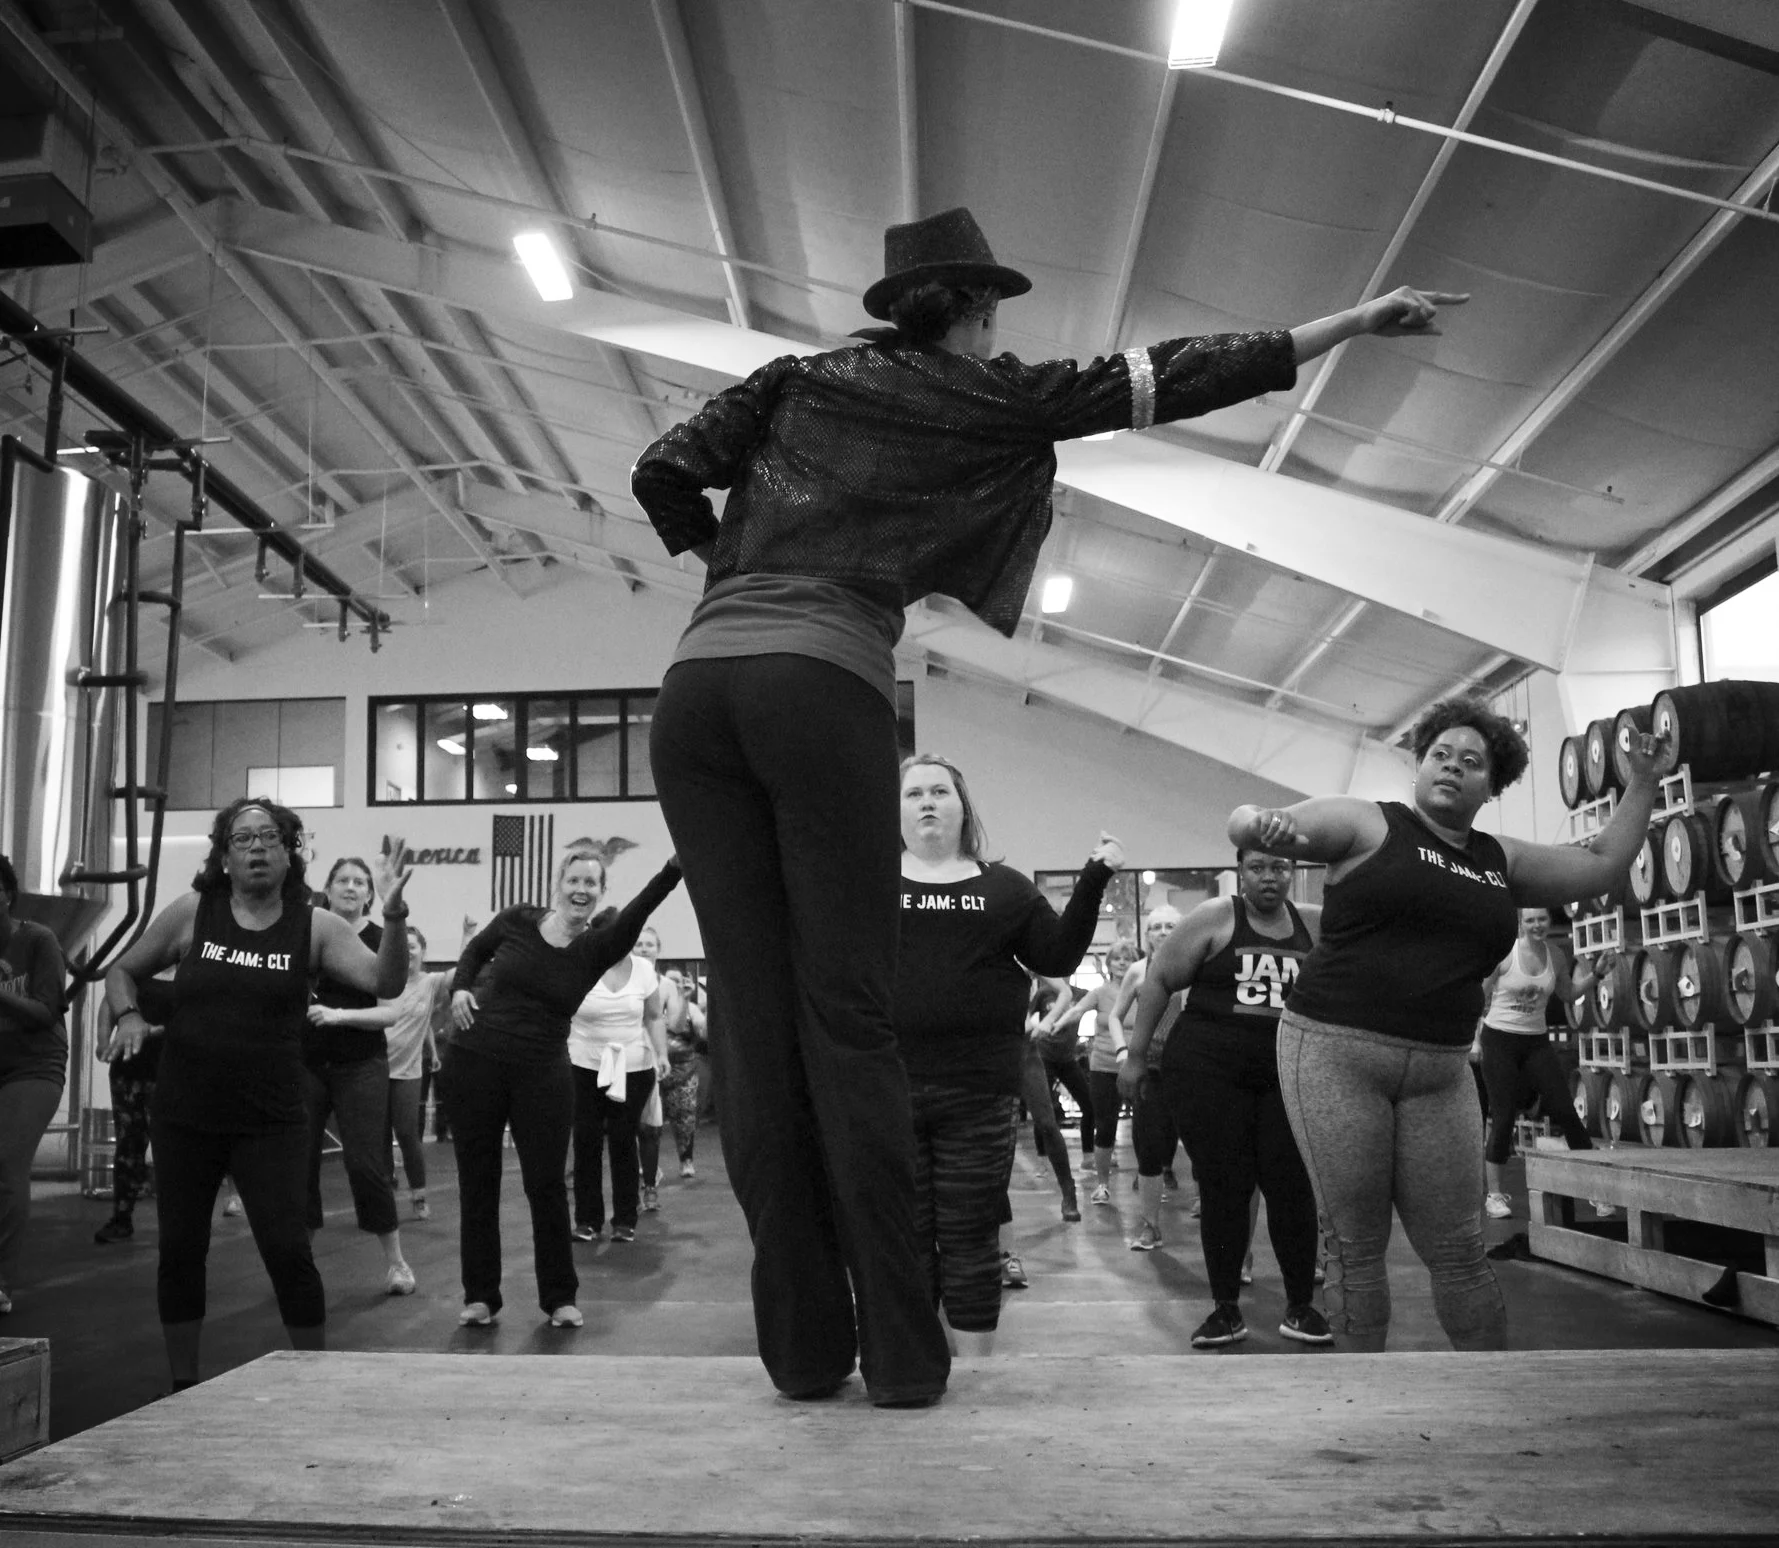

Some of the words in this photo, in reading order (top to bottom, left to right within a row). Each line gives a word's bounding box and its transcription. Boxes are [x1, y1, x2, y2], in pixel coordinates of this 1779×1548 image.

[1417, 846, 1446, 869] THE
[916, 894, 956, 910] JAM:
[961, 894, 986, 911] CLT
[201, 941, 228, 961] THE
[226, 949, 264, 968] JAM:
[267, 953, 291, 971] CLT
[1236, 981, 1286, 1009] CL
